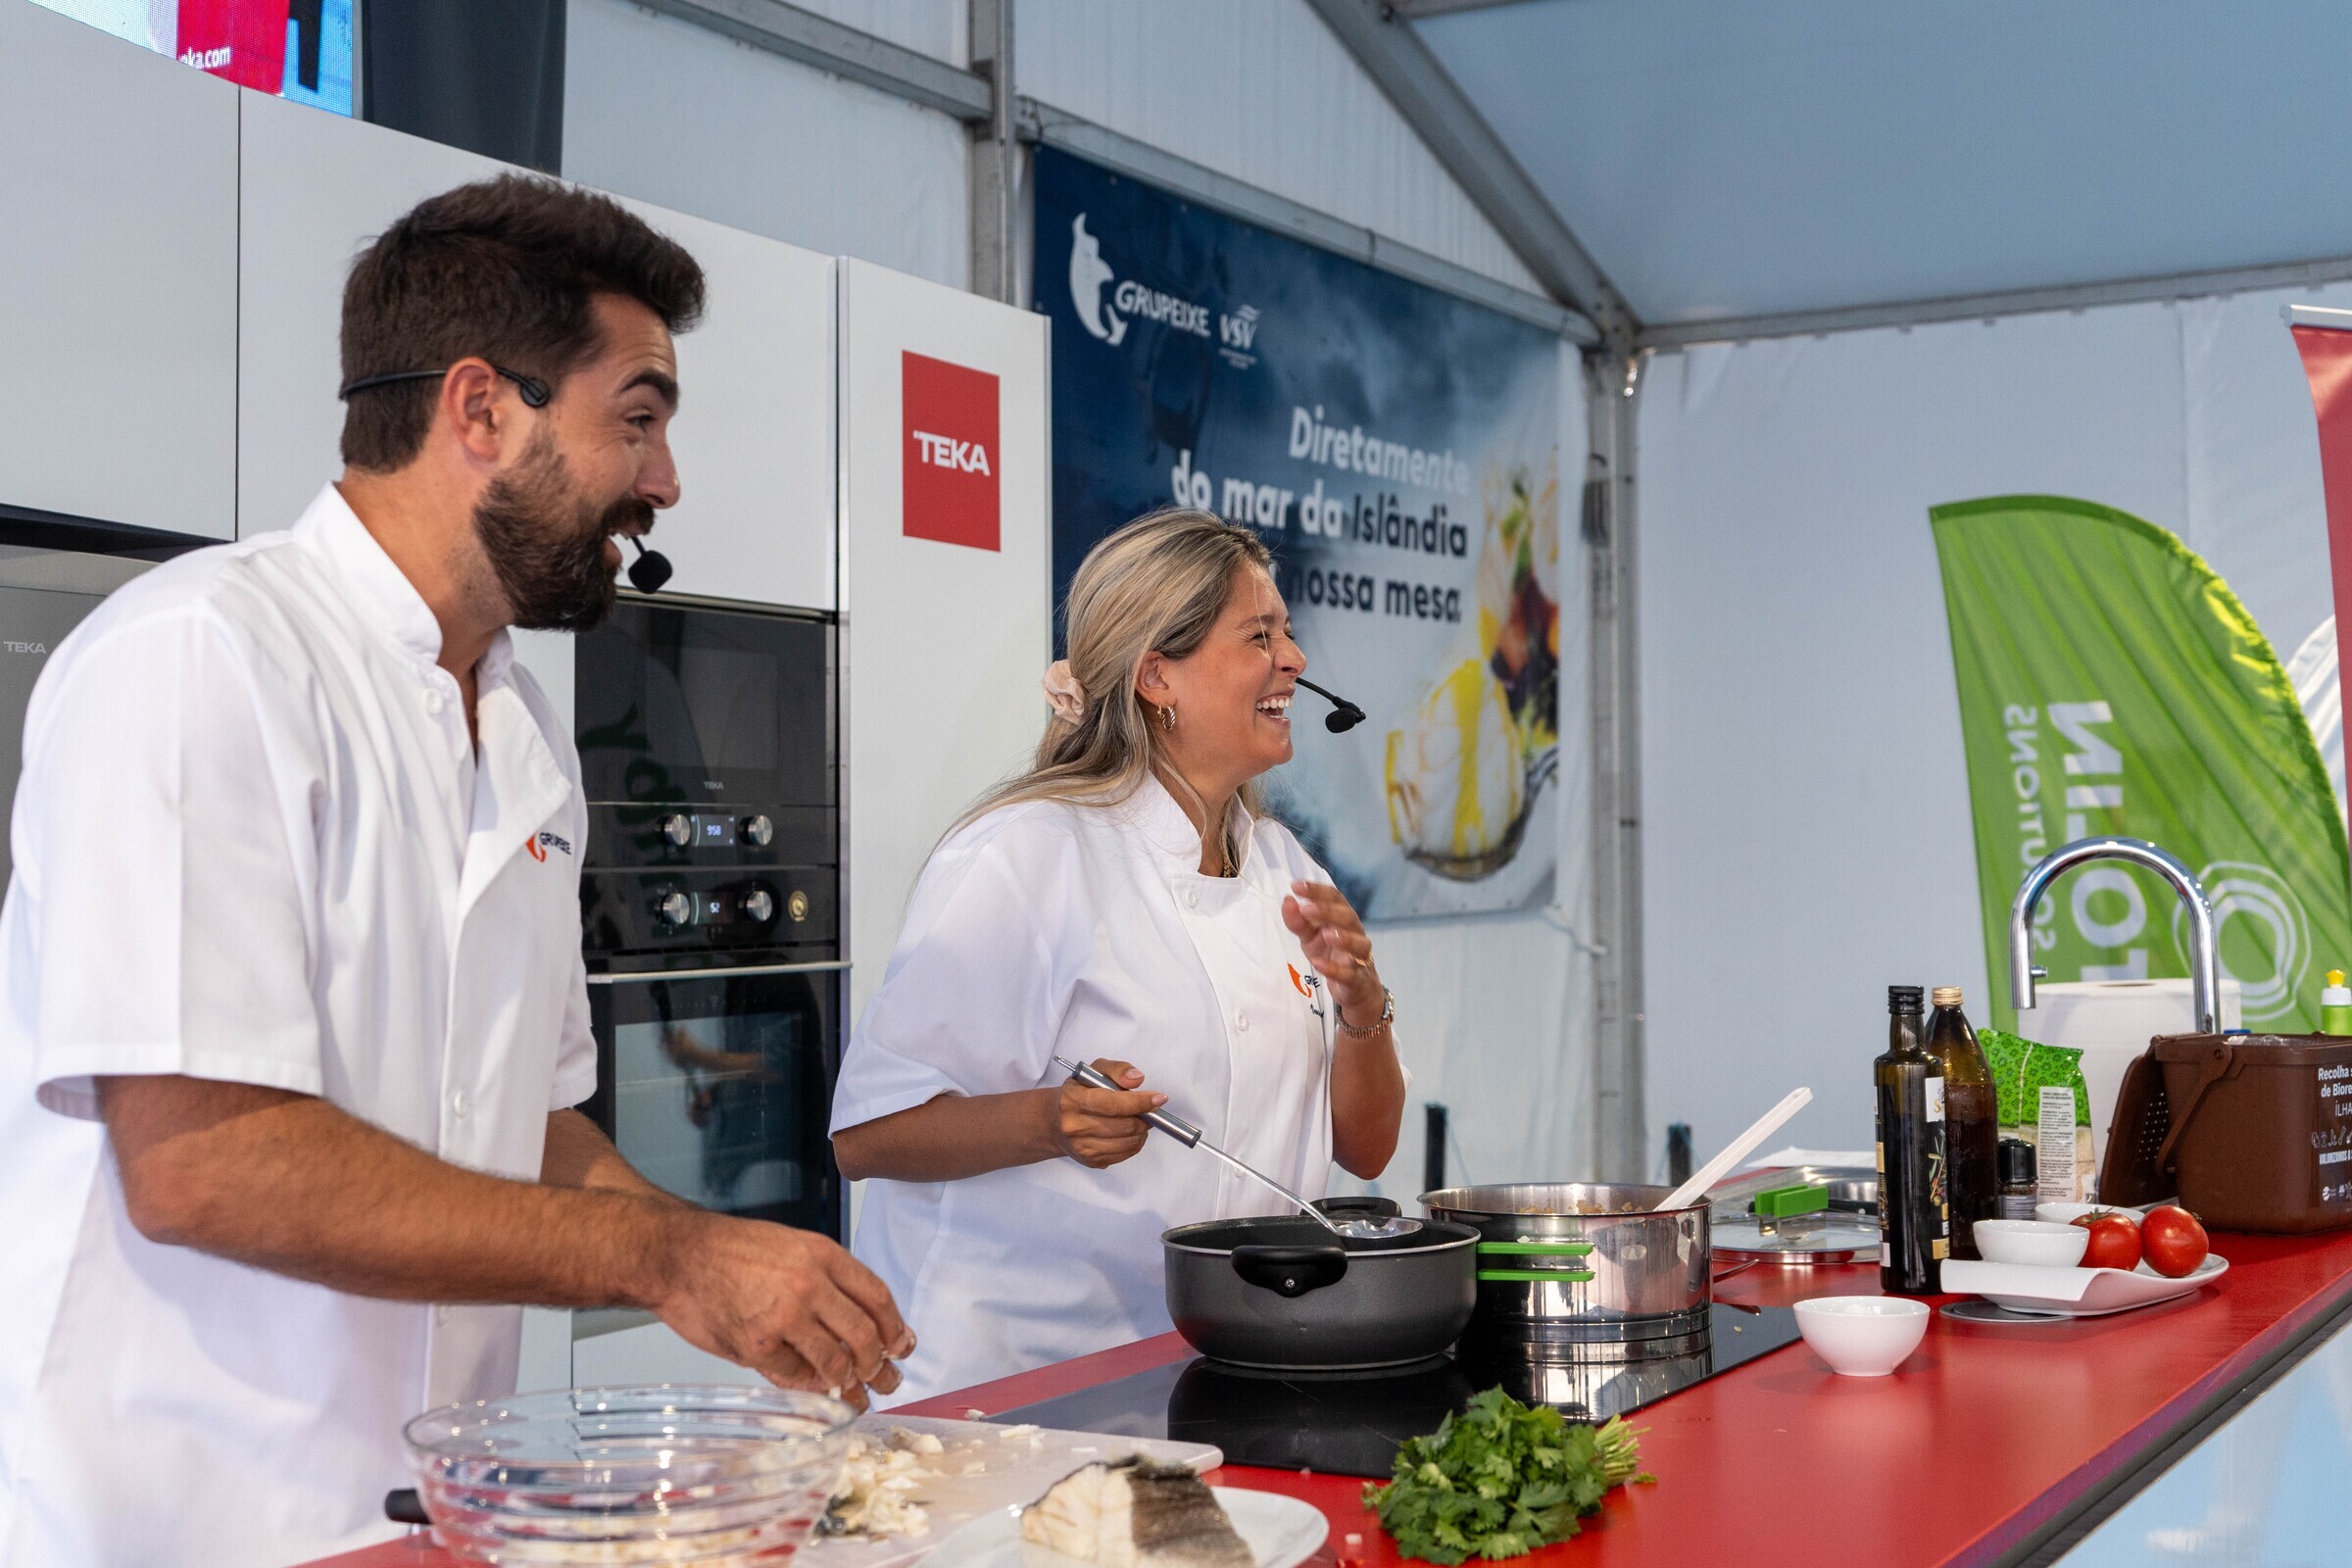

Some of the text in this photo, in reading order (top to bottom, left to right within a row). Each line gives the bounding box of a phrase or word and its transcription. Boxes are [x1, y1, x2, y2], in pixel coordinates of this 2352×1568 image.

[1114, 279, 1211, 338] GRUPEIXE
[1219, 313, 1257, 349] VSV
[912, 430, 991, 476] TEKA
[1289, 405, 1469, 495] Diretamente
[1171, 448, 1467, 558] do mar da Islândia
[3, 640, 47, 655] TEKA
[704, 781, 724, 791] TEKA
[2318, 1064, 2349, 1081] Recolha
[2321, 1083, 2331, 1098] de
